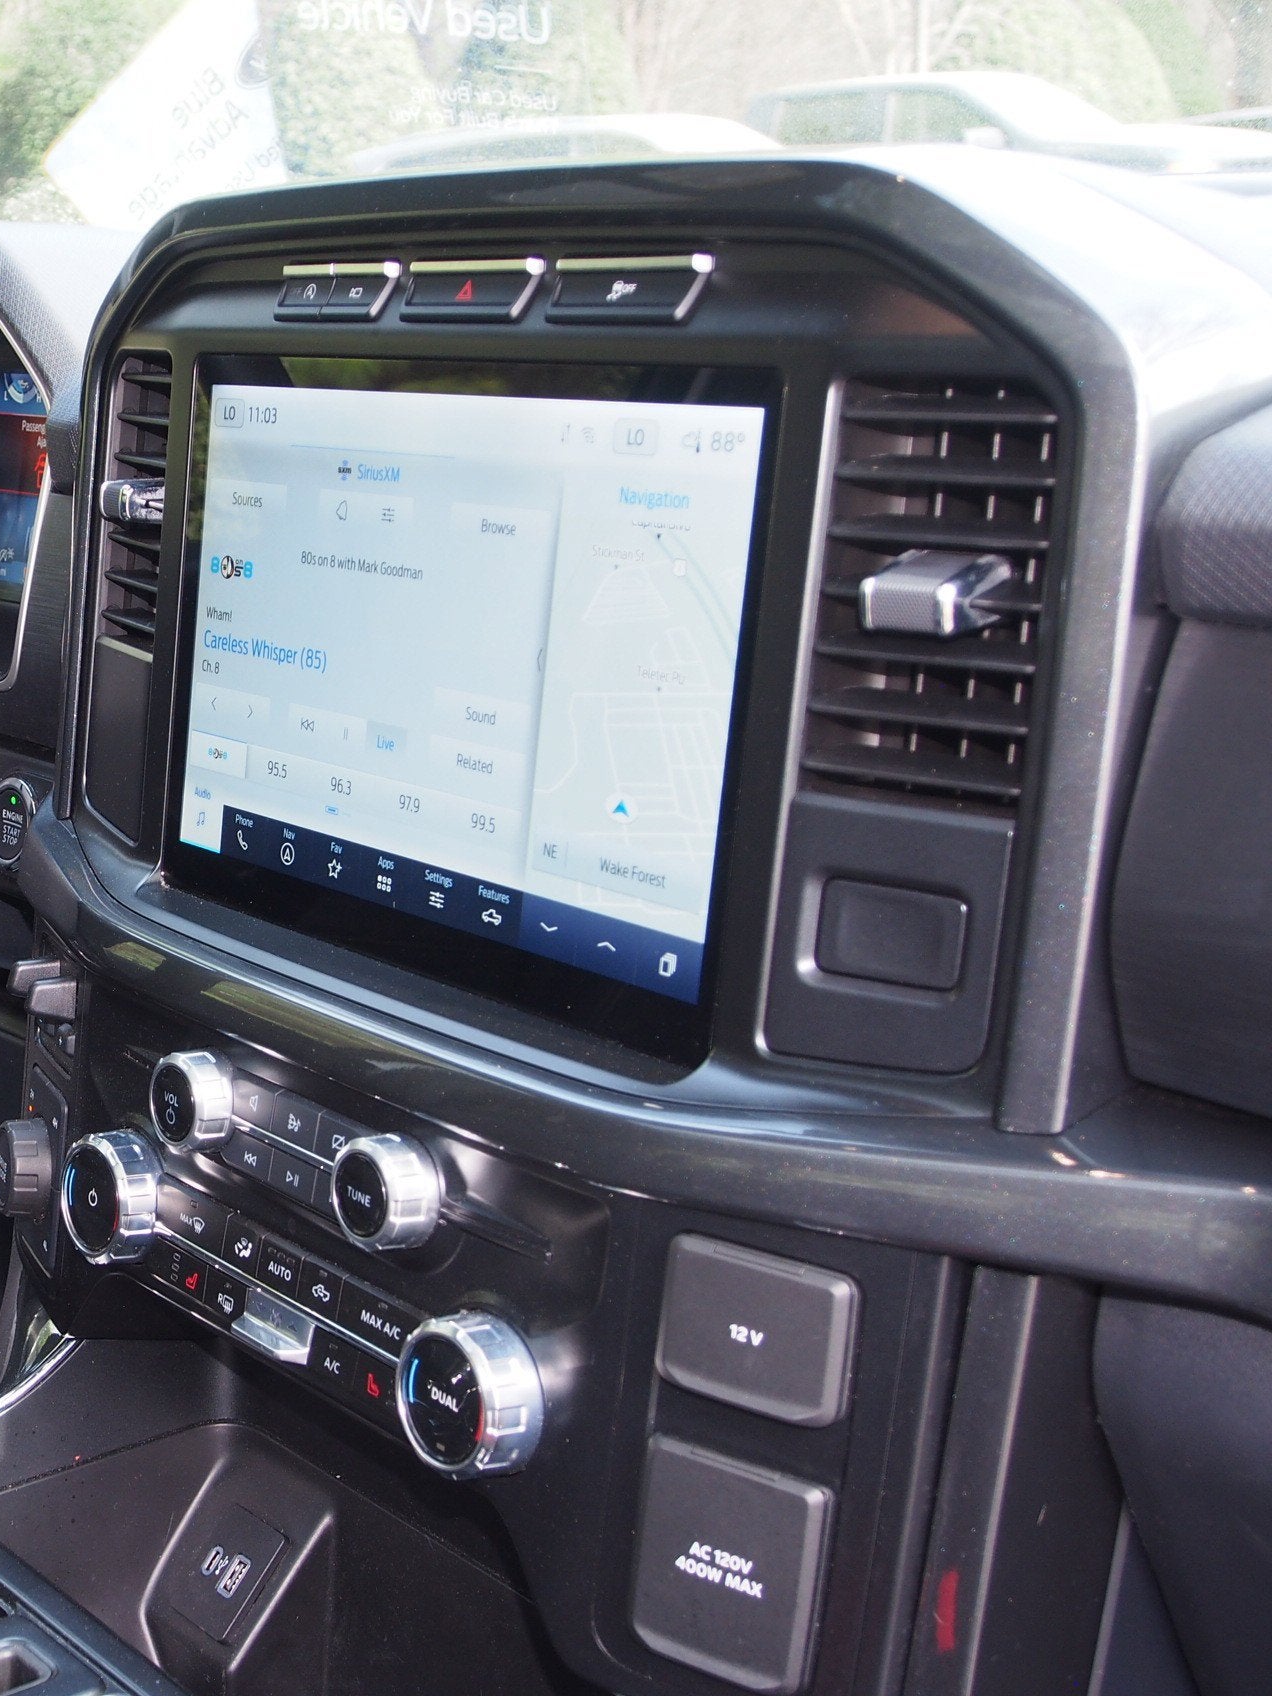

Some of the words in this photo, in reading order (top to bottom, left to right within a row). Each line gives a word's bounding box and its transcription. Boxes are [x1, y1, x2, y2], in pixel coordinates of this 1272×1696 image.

[4, 391, 8, 401] L
[223, 406, 236, 421] LO
[248, 406, 277, 424] 11:03
[627, 428, 645, 446] LO
[357, 463, 401, 482] SiriusXM
[232, 491, 263, 508] Sources
[619, 486, 690, 510] Navigation
[481, 518, 517, 536] Browse
[301, 551, 317, 566] 80s
[317, 555, 327, 567] on
[330, 554, 336, 567] 8
[337, 554, 356, 571] with
[357, 557, 378, 574] Mark
[380, 560, 423, 580] Goodman
[206, 606, 233, 623] Wham!
[204, 630, 249, 655] Careless
[251, 638, 297, 666] Whisper
[300, 647, 328, 673] (85)
[202, 659, 213, 673] Ch.
[214, 661, 220, 674] 8
[465, 706, 496, 726] Sound
[376, 734, 395, 751] Live
[456, 753, 494, 775] Related
[194, 786, 211, 800] Audio
[267, 760, 288, 779] 95.5
[330, 776, 352, 796] 96.3
[398, 794, 420, 813] 97.9
[471, 812, 496, 833] 99.5
[2, 808, 23, 824] ENGINE
[235, 813, 254, 828] Phone
[2, 824, 20, 837] START
[283, 827, 296, 841] Nav
[2, 834, 18, 846] STOP
[331, 841, 342, 855] Fav
[378, 855, 395, 871] Apps
[543, 842, 558, 860] NE
[599, 856, 629, 878] Wake
[631, 865, 666, 888] Forest
[424, 869, 453, 889] Settings
[478, 885, 510, 905] Features
[164, 1091, 179, 1108] VOL
[347, 1186, 371, 1208] TUNE
[179, 1213, 193, 1227] MAX
[268, 1261, 292, 1281] AUTO
[360, 1309, 383, 1333] MAX
[383, 1321, 402, 1341] A/C
[324, 1356, 341, 1375] A/C
[430, 1386, 460, 1413] DUAL
[688, 1541, 712, 1559] AC
[714, 1548, 754, 1575] 120V
[674, 1555, 723, 1583] 400W
[725, 1571, 763, 1599] MAX
